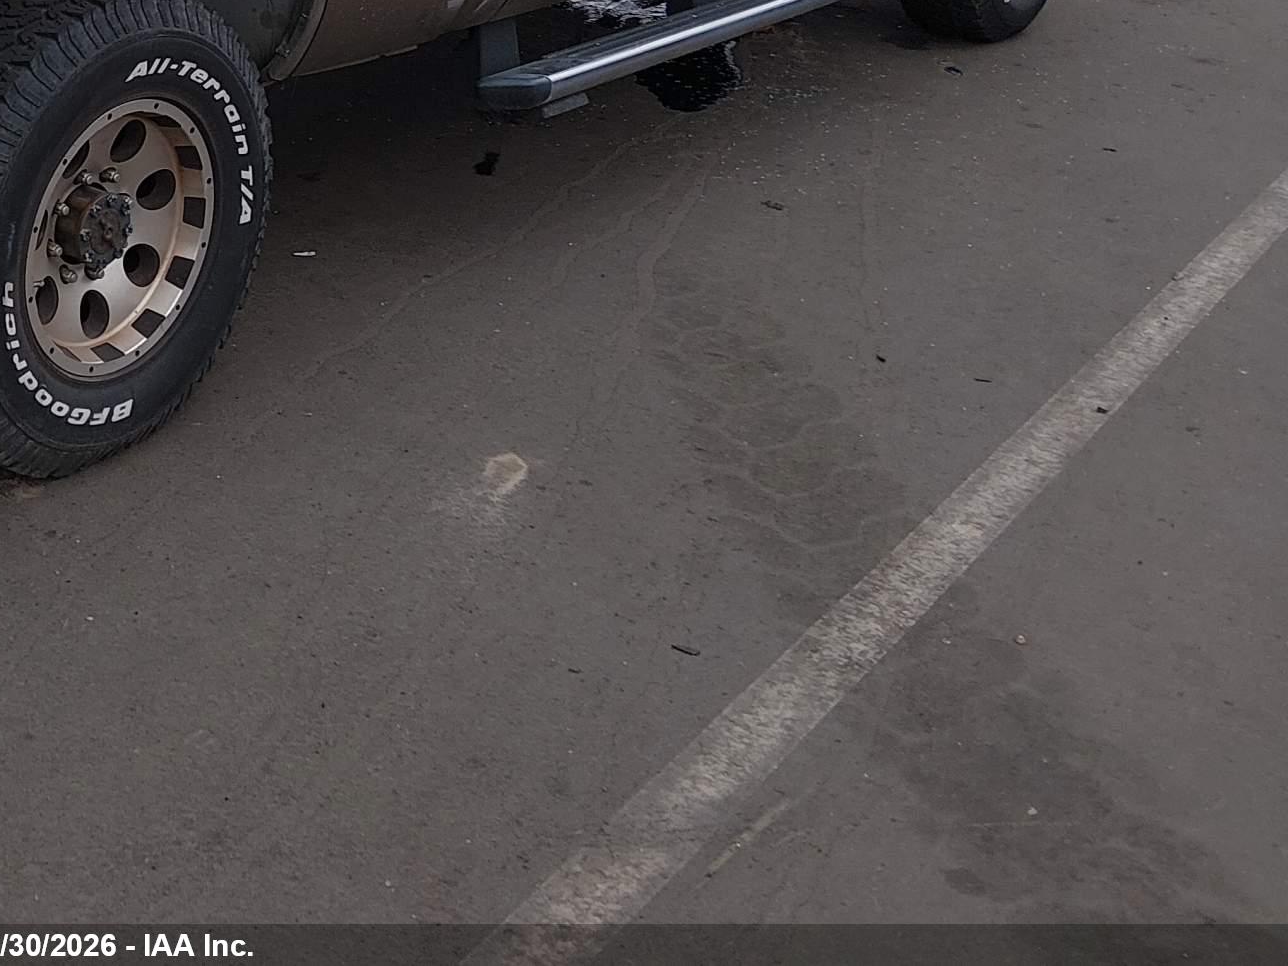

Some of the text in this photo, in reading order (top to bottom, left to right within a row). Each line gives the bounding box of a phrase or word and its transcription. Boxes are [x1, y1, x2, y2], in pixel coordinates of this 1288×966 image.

[125, 57, 253, 225] All-Terrain T/A
[2, 281, 134, 426] BFGoodrich
